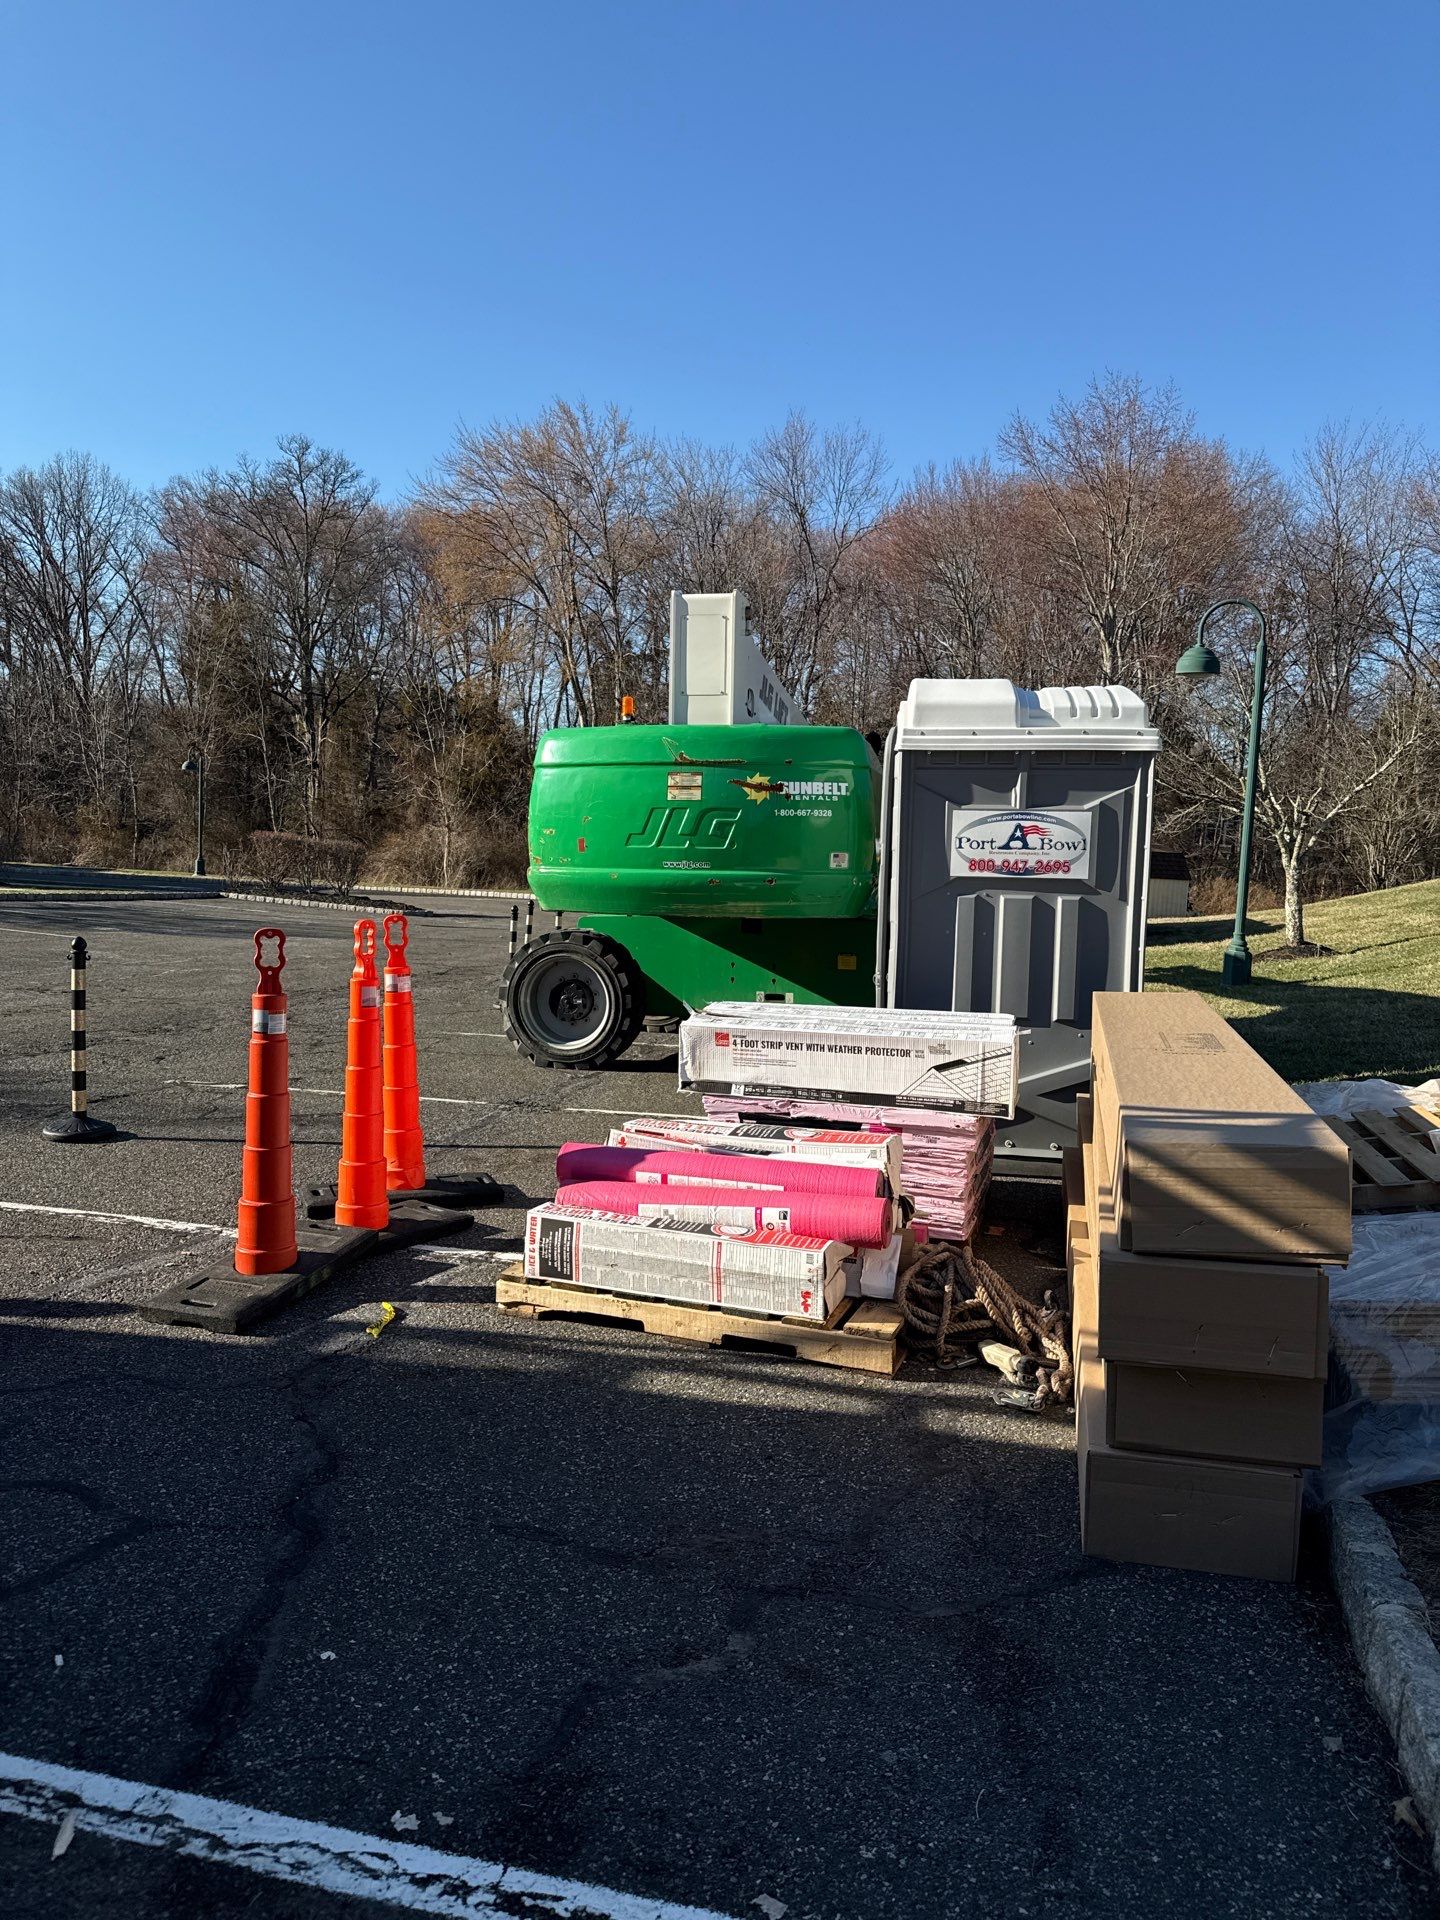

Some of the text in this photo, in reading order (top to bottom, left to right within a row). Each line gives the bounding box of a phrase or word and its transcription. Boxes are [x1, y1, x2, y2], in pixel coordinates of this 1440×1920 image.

[774, 809, 832, 817] 1-800-667-9328
[987, 813, 1057, 823] www.portabowlinc.com
[625, 807, 742, 849] JLG
[955, 822, 1088, 851] Port A Bowl
[663, 861, 711, 869] www.jlg.com
[968, 858, 1072, 874] 800-947-2695
[732, 1039, 760, 1049] 4-FOOT
[761, 1040, 783, 1050] STRIP
[785, 1042, 803, 1051] VENT
[805, 1043, 825, 1053] WITH
[827, 1044, 863, 1055] WEATHER
[865, 1046, 911, 1058] PROTECTOR
[529, 1216, 538, 1245] WATER
[528, 1254, 536, 1267] ICE
